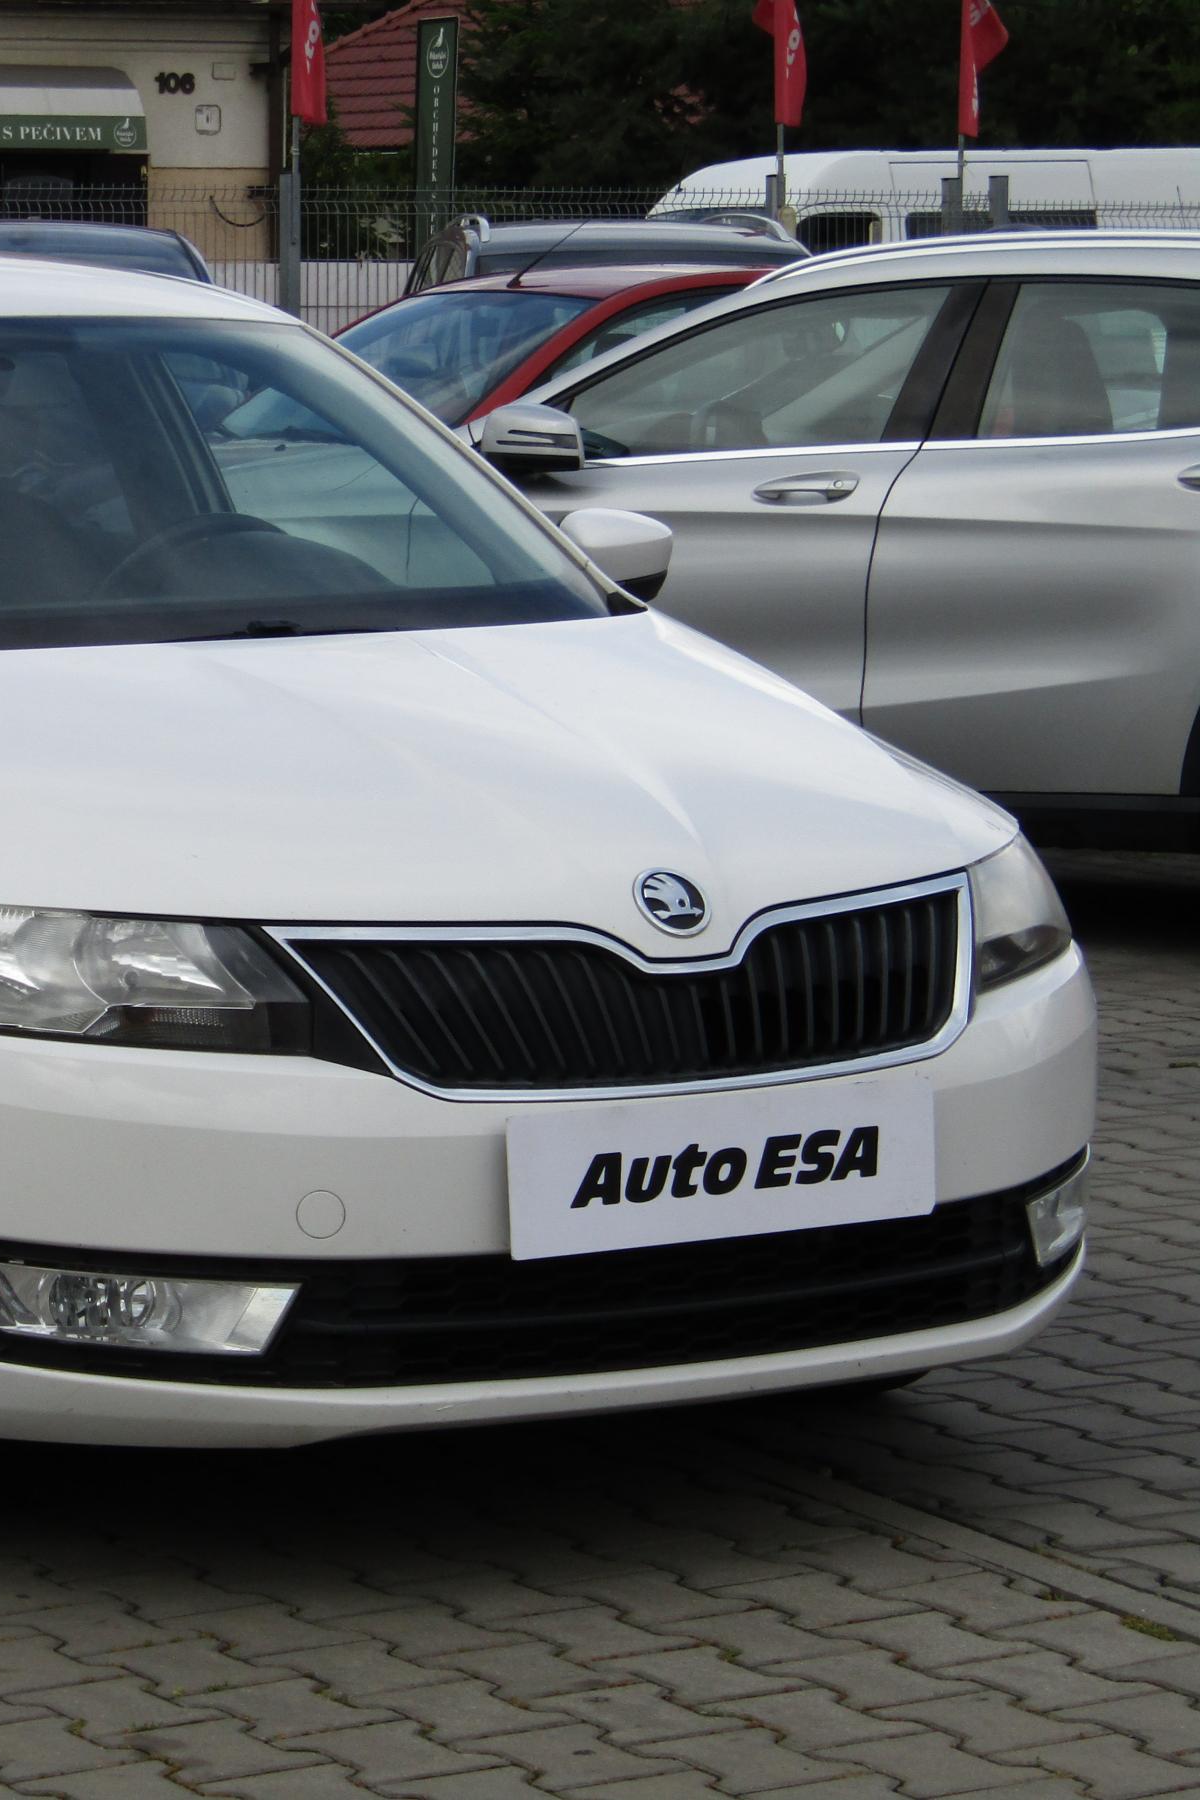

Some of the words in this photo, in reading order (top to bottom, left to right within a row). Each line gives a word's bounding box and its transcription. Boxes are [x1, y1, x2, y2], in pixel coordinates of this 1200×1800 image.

[154, 71, 196, 95] 106
[2, 126, 13, 140] S
[19, 123, 102, 141] PEČIVEM
[570, 1143, 747, 1209] Auto
[754, 1125, 879, 1190] ESA
